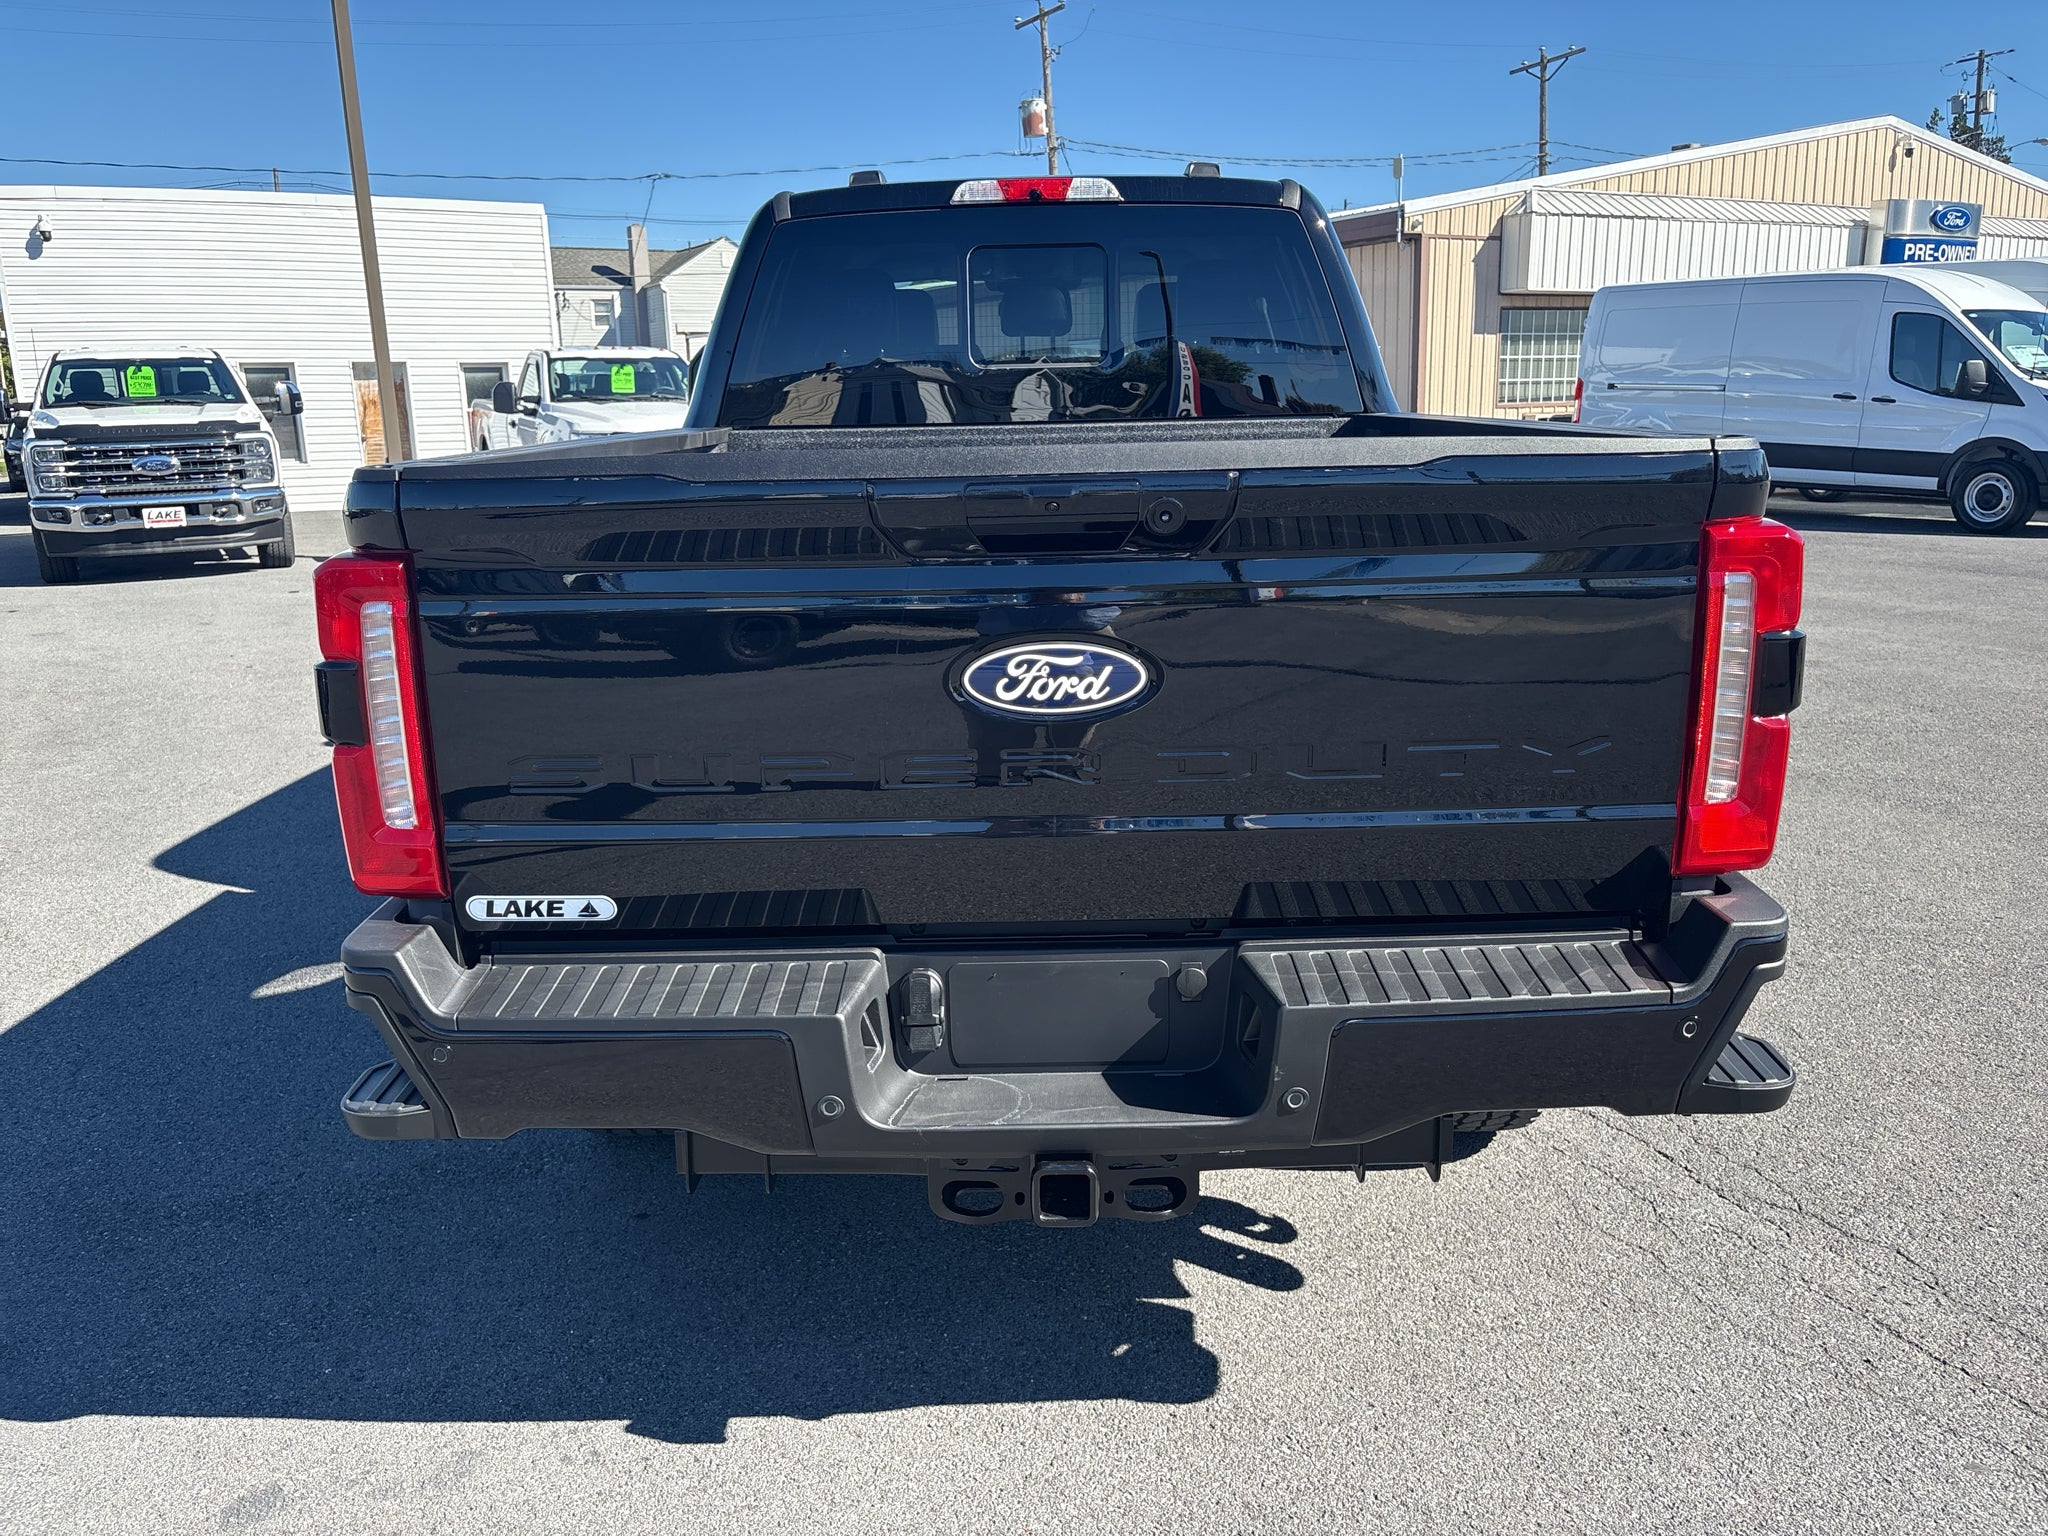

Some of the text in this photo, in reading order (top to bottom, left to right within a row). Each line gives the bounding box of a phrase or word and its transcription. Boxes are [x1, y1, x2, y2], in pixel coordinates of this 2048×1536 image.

[1944, 211, 1966, 227] Ford
[1903, 243, 1977, 262] PRE-OWNED
[147, 510, 182, 520] LAKE
[995, 654, 1114, 701] Ford
[507, 735, 1614, 793] SUPER DUTY
[485, 900, 566, 918] LAKE
